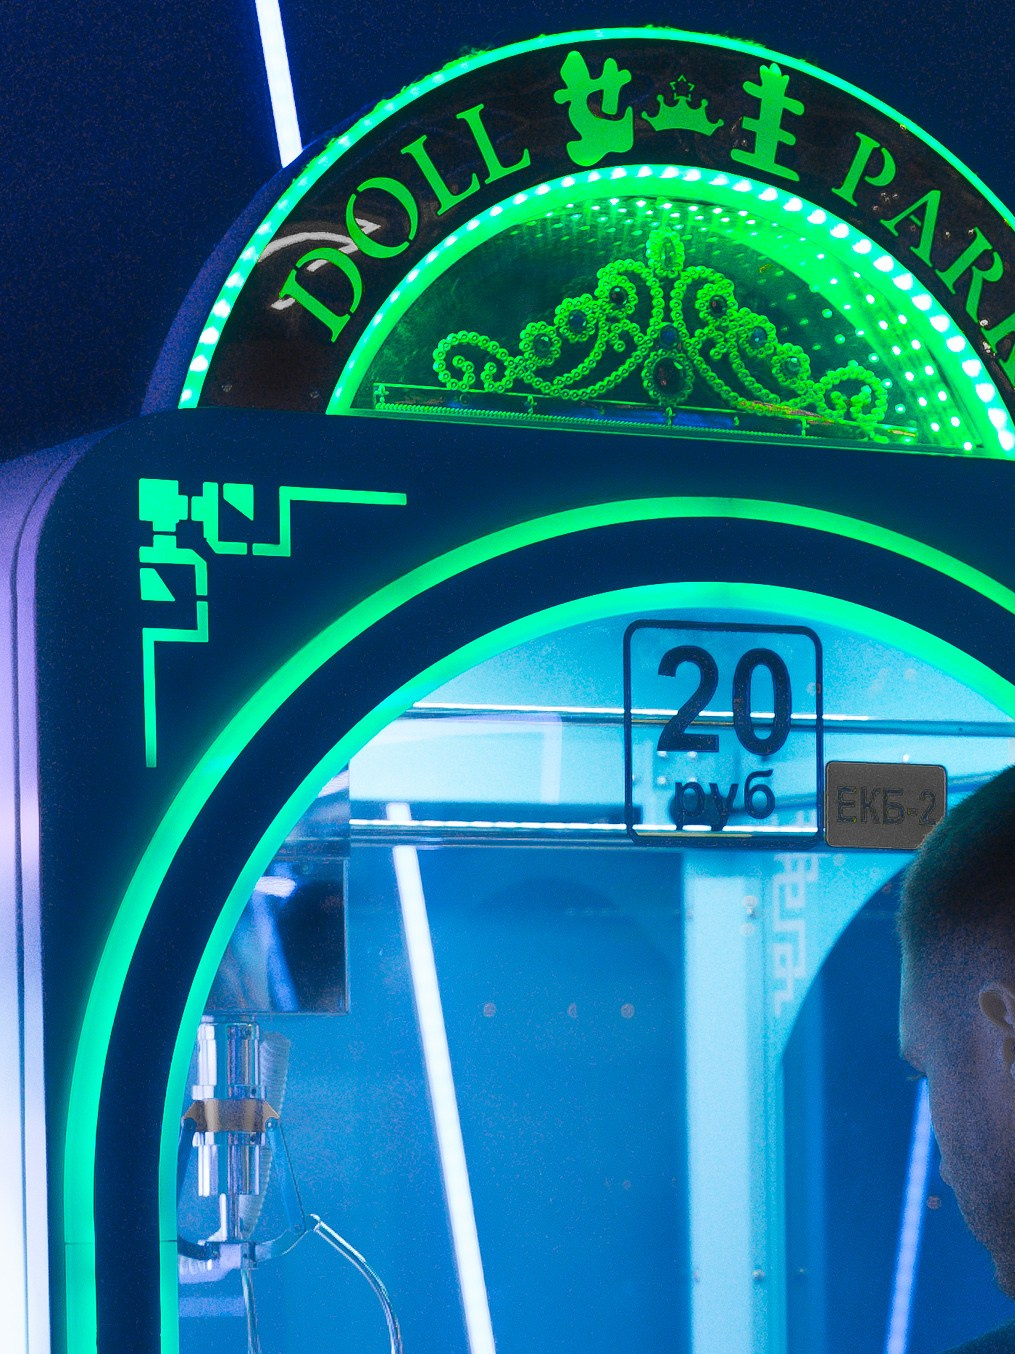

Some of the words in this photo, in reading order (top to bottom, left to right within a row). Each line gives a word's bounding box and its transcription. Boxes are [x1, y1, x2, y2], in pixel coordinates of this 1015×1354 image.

[278, 102, 531, 343] DOLL
[656, 644, 793, 756] 20
[674, 768, 776, 832] руб
[836, 785, 937, 827] ЕКБ-2
